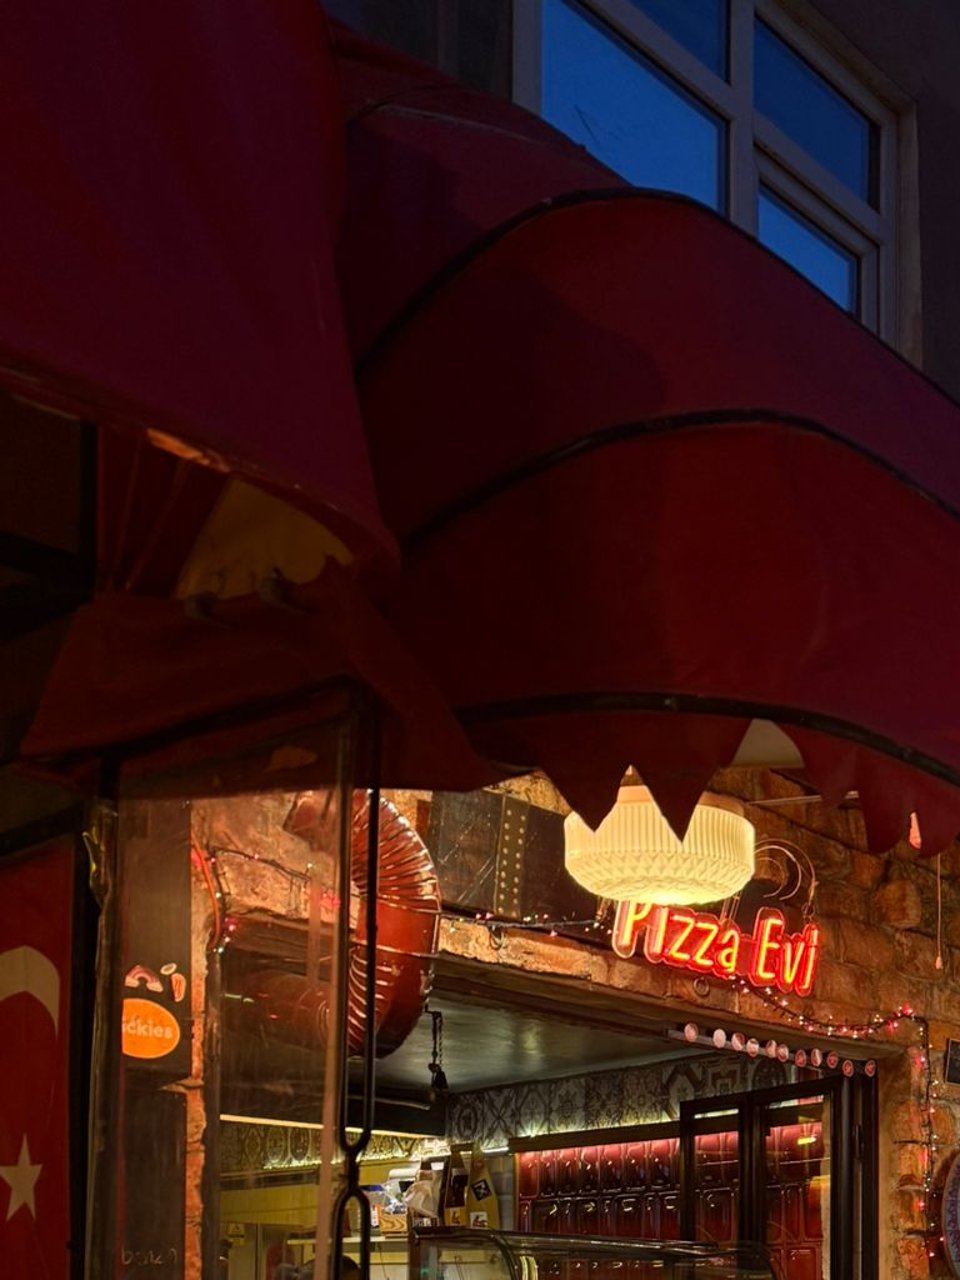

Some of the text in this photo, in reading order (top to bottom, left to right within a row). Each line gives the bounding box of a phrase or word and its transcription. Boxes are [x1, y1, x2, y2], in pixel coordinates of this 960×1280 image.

[618, 900, 819, 991] Pizza Evi
[123, 1016, 173, 1040] ckies
